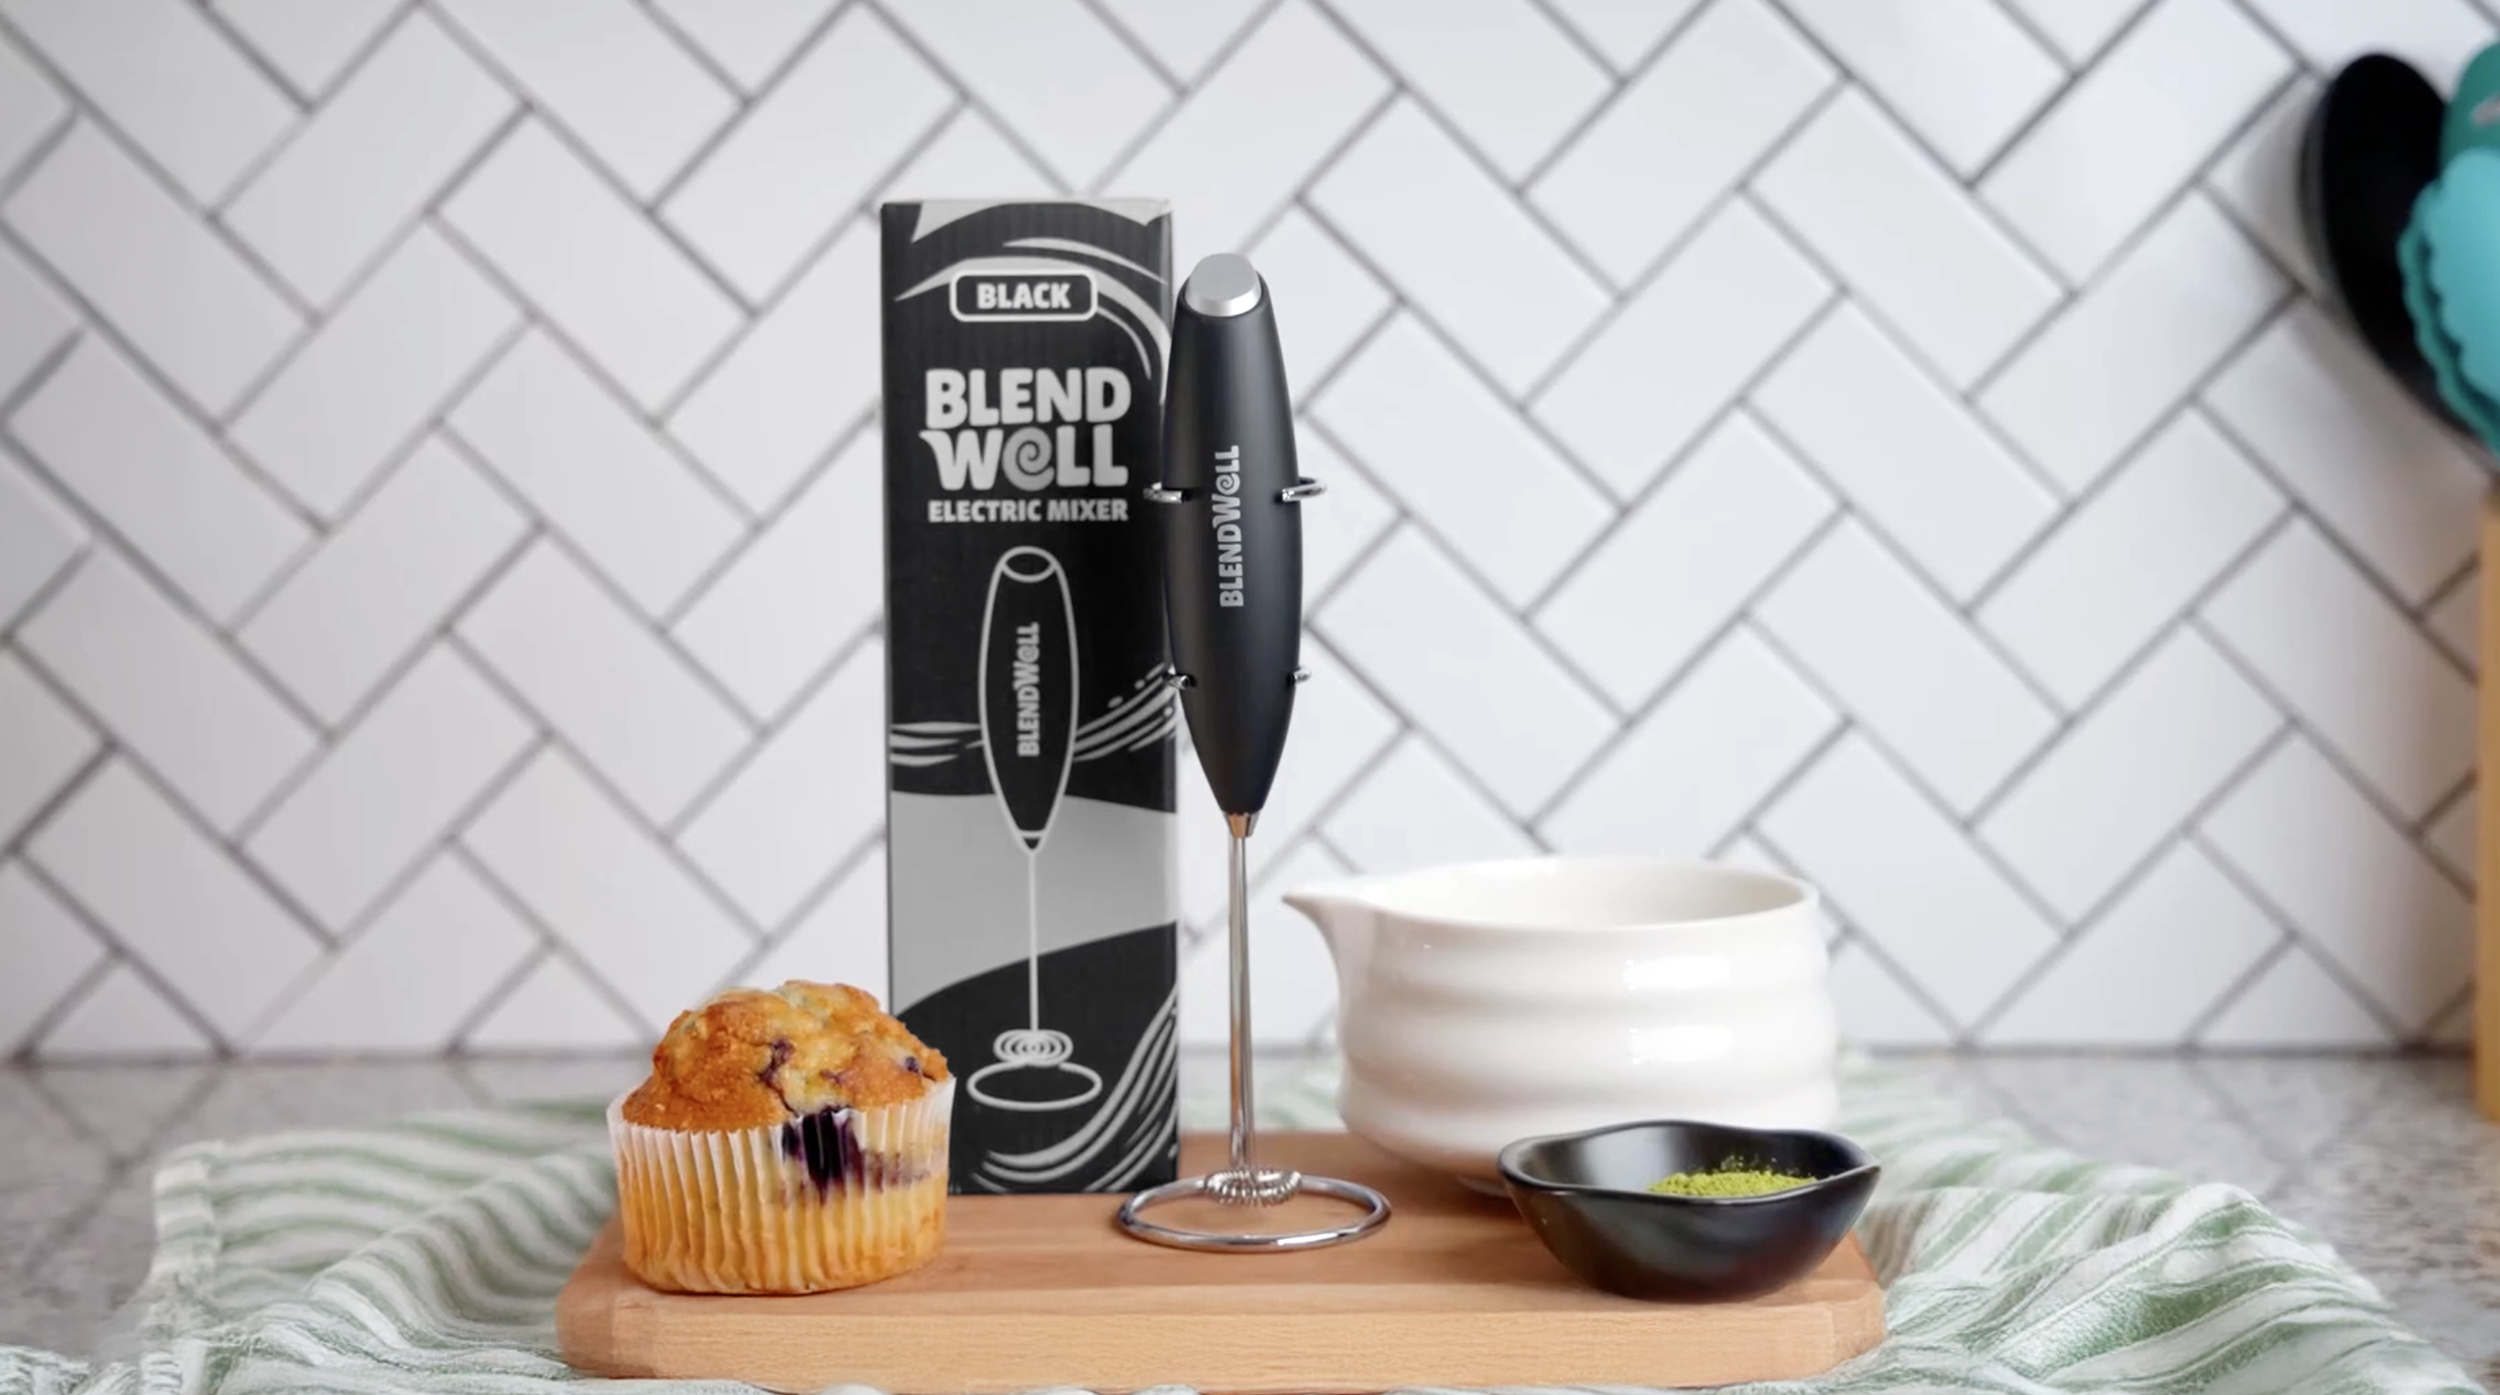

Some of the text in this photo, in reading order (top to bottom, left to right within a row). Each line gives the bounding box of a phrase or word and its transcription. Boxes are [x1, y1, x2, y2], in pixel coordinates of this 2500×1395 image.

[977, 282, 1071, 310] BLACK
[925, 367, 1131, 429] BLEND
[928, 499, 1129, 523] ELECTRIC MIXER
